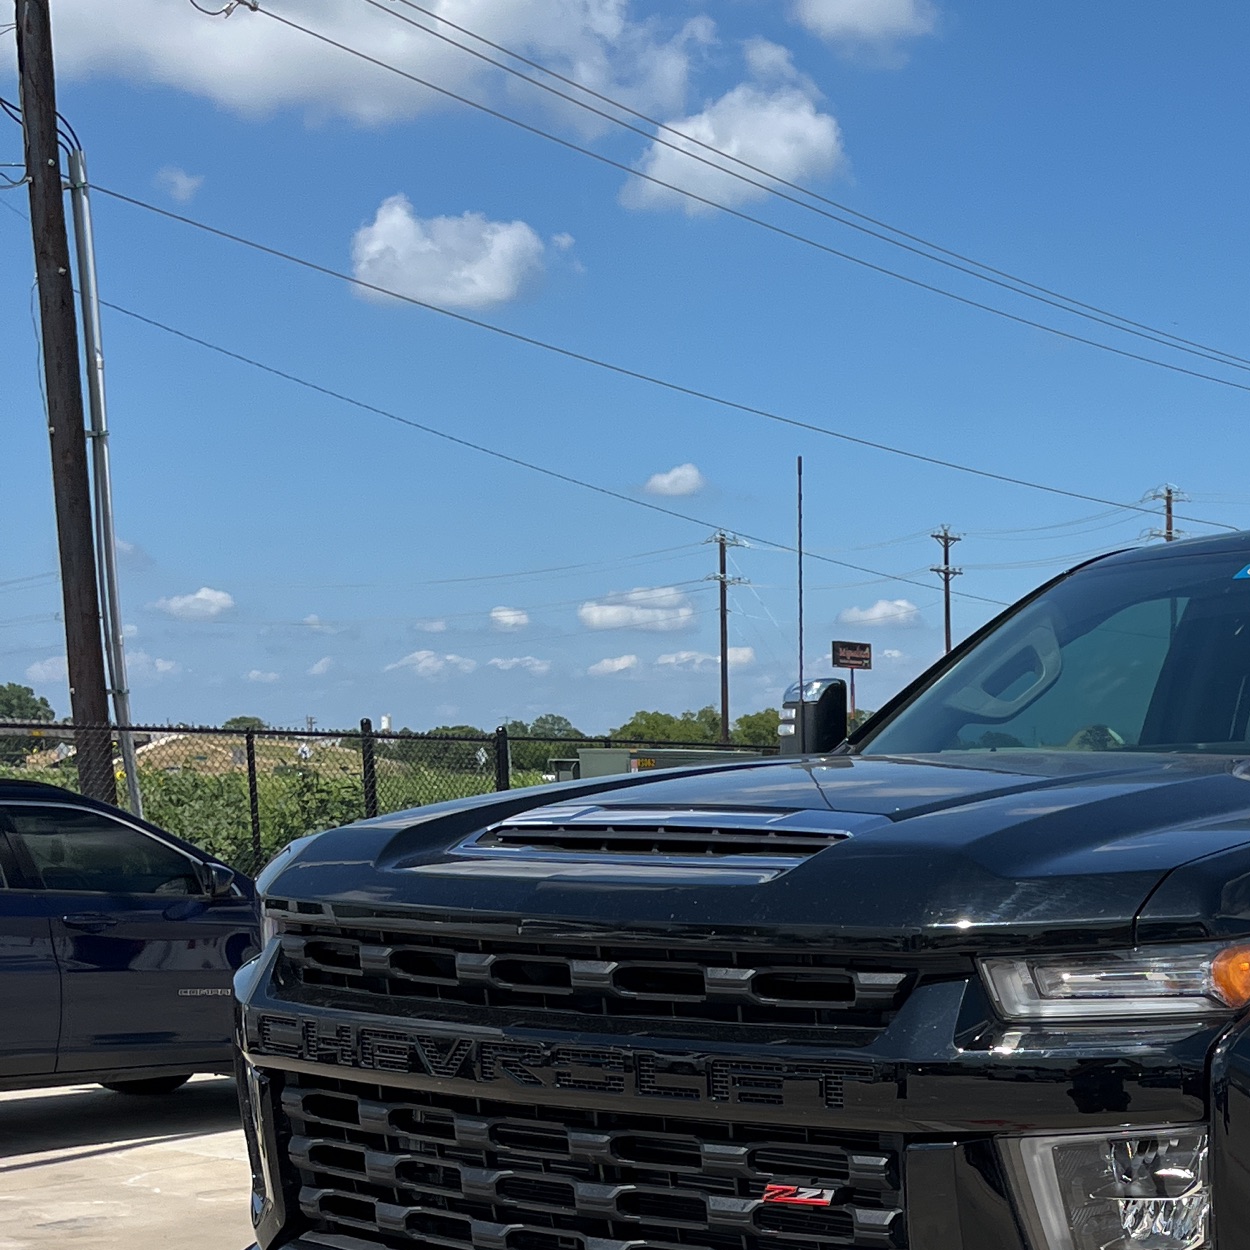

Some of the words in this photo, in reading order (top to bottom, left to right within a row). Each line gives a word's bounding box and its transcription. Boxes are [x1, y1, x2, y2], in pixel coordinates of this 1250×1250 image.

[178, 988, 232, 996] COMPA
[258, 1013, 877, 1110] CHEVROLET
[762, 1183, 835, 1207] Z71
